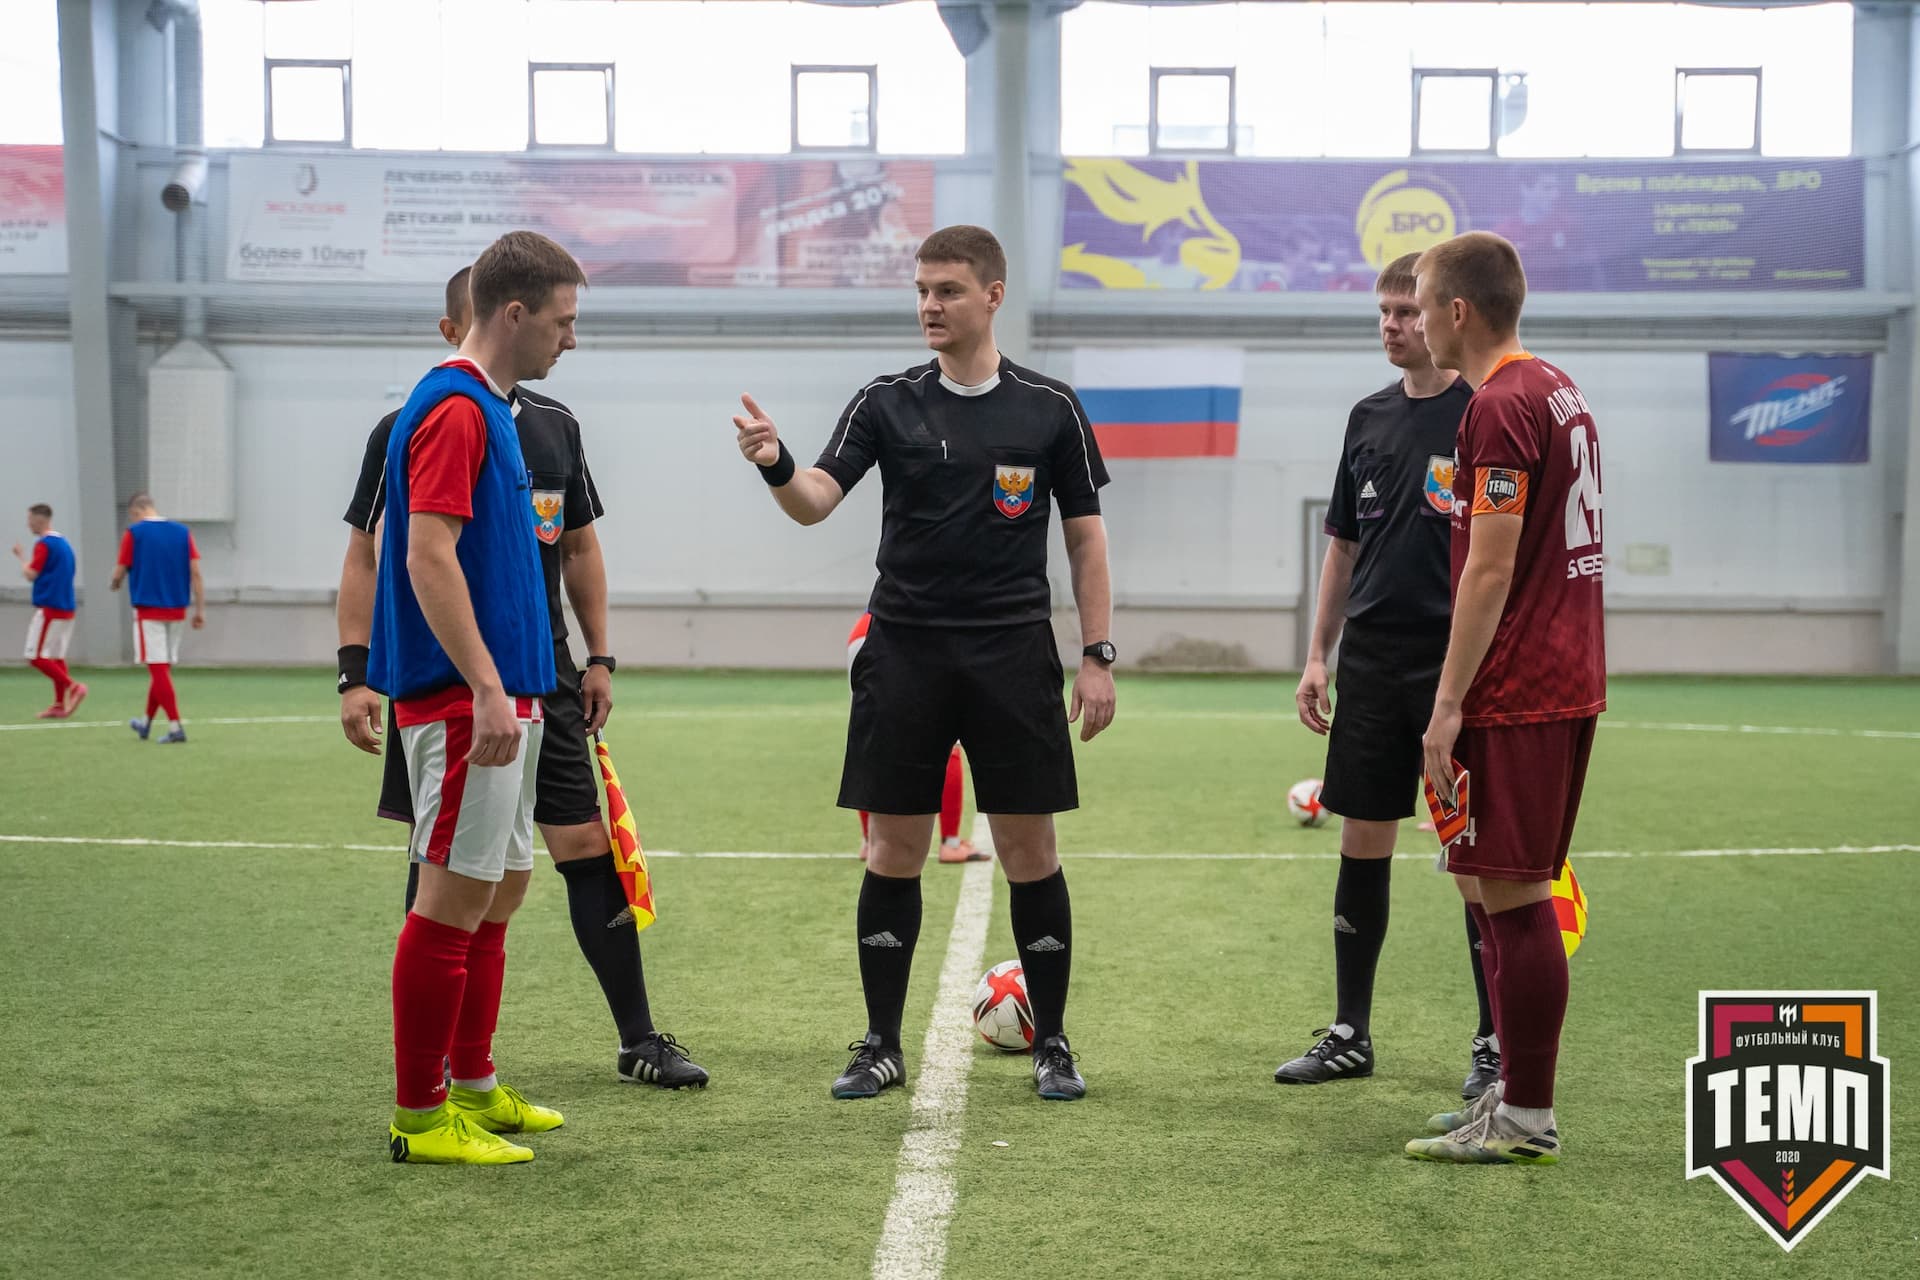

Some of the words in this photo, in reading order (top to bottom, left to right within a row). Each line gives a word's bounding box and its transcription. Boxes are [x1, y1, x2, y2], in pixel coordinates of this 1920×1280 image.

[384, 210, 463, 225] ДЕТСКИЙ
[240, 243, 302, 261] более
[1488, 479, 1516, 498] ТЕМП
[1455, 816, 1478, 847] 4
